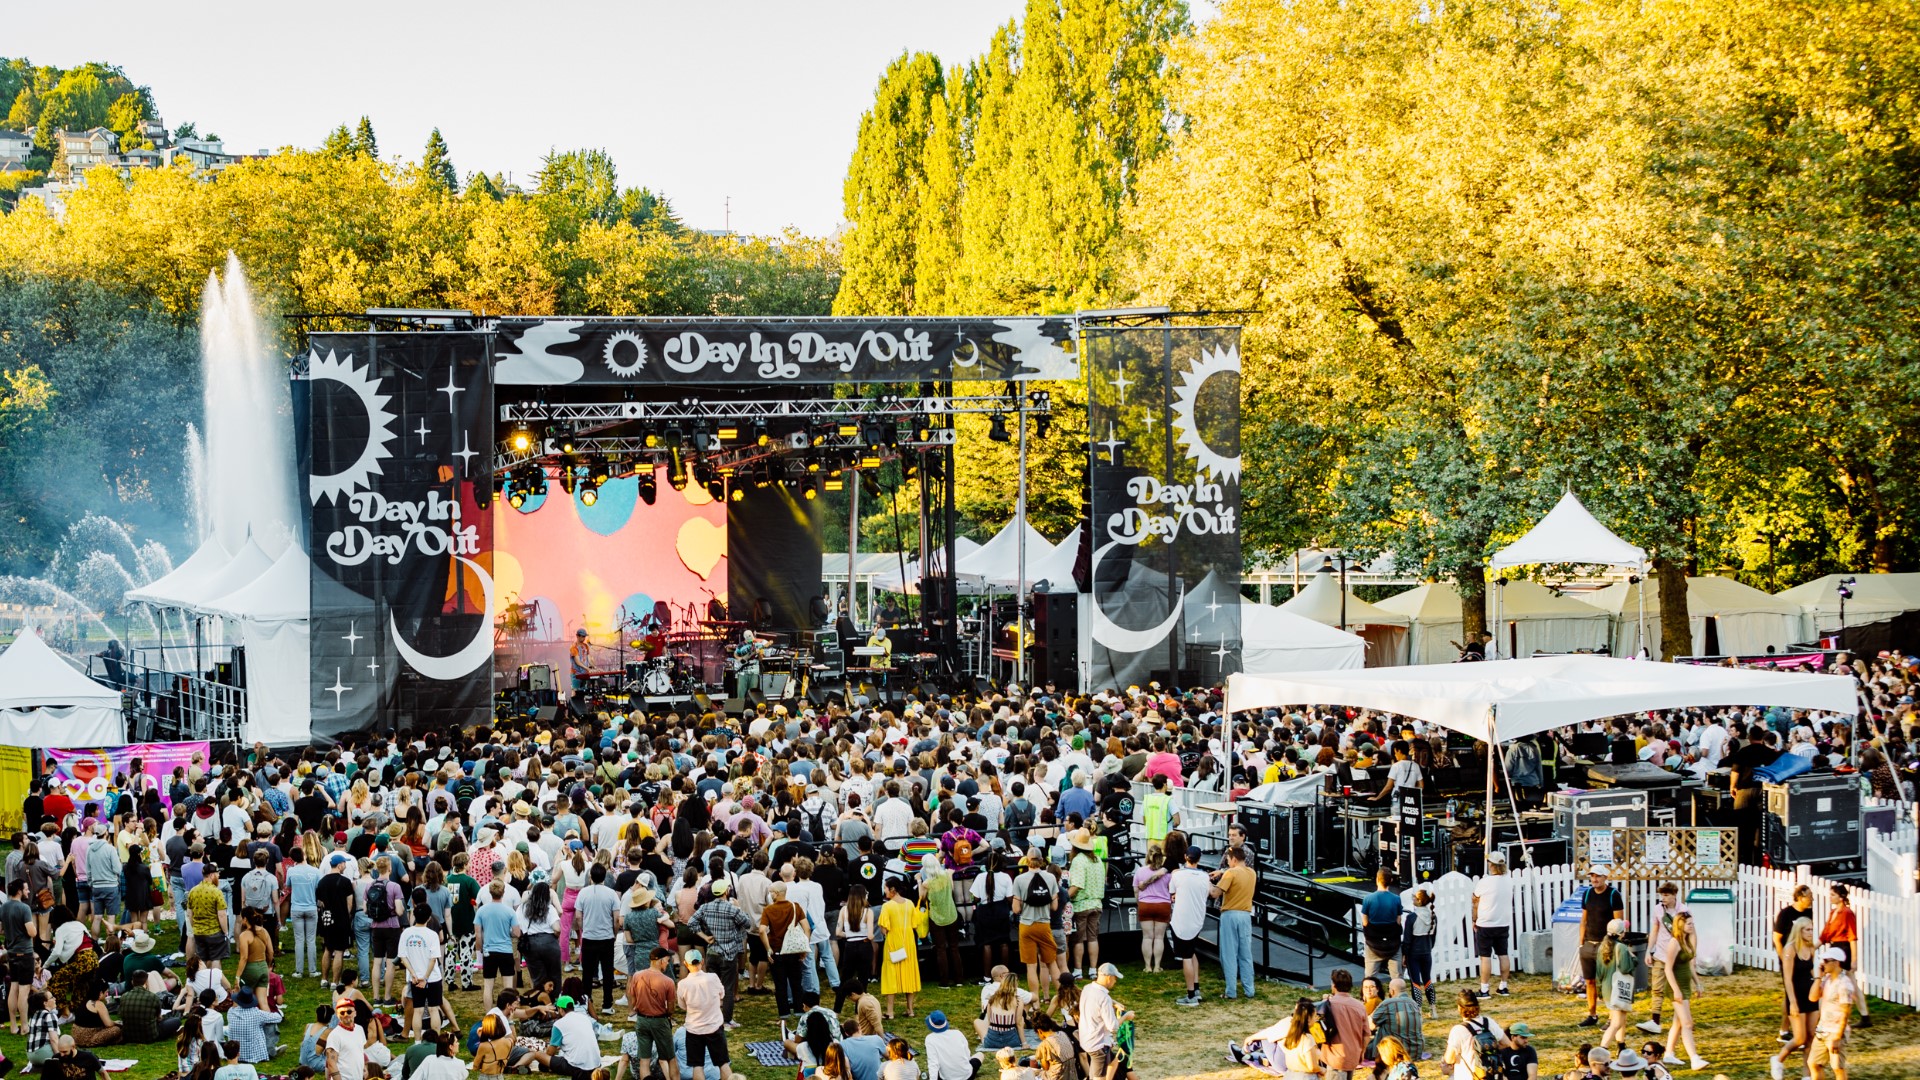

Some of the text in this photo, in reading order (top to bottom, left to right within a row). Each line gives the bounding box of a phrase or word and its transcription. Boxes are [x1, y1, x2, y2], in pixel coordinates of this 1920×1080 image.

[664, 327, 933, 378] Day In Day Out
[349, 491, 461, 531] Day In
[1127, 475, 1223, 512] Day In
[1107, 503, 1236, 545] Day Out
[326, 521, 480, 566] Day Out
[1402, 806, 1419, 816] ACCESS
[1404, 796, 1415, 805] ADA
[1404, 816, 1417, 826] ONLY
